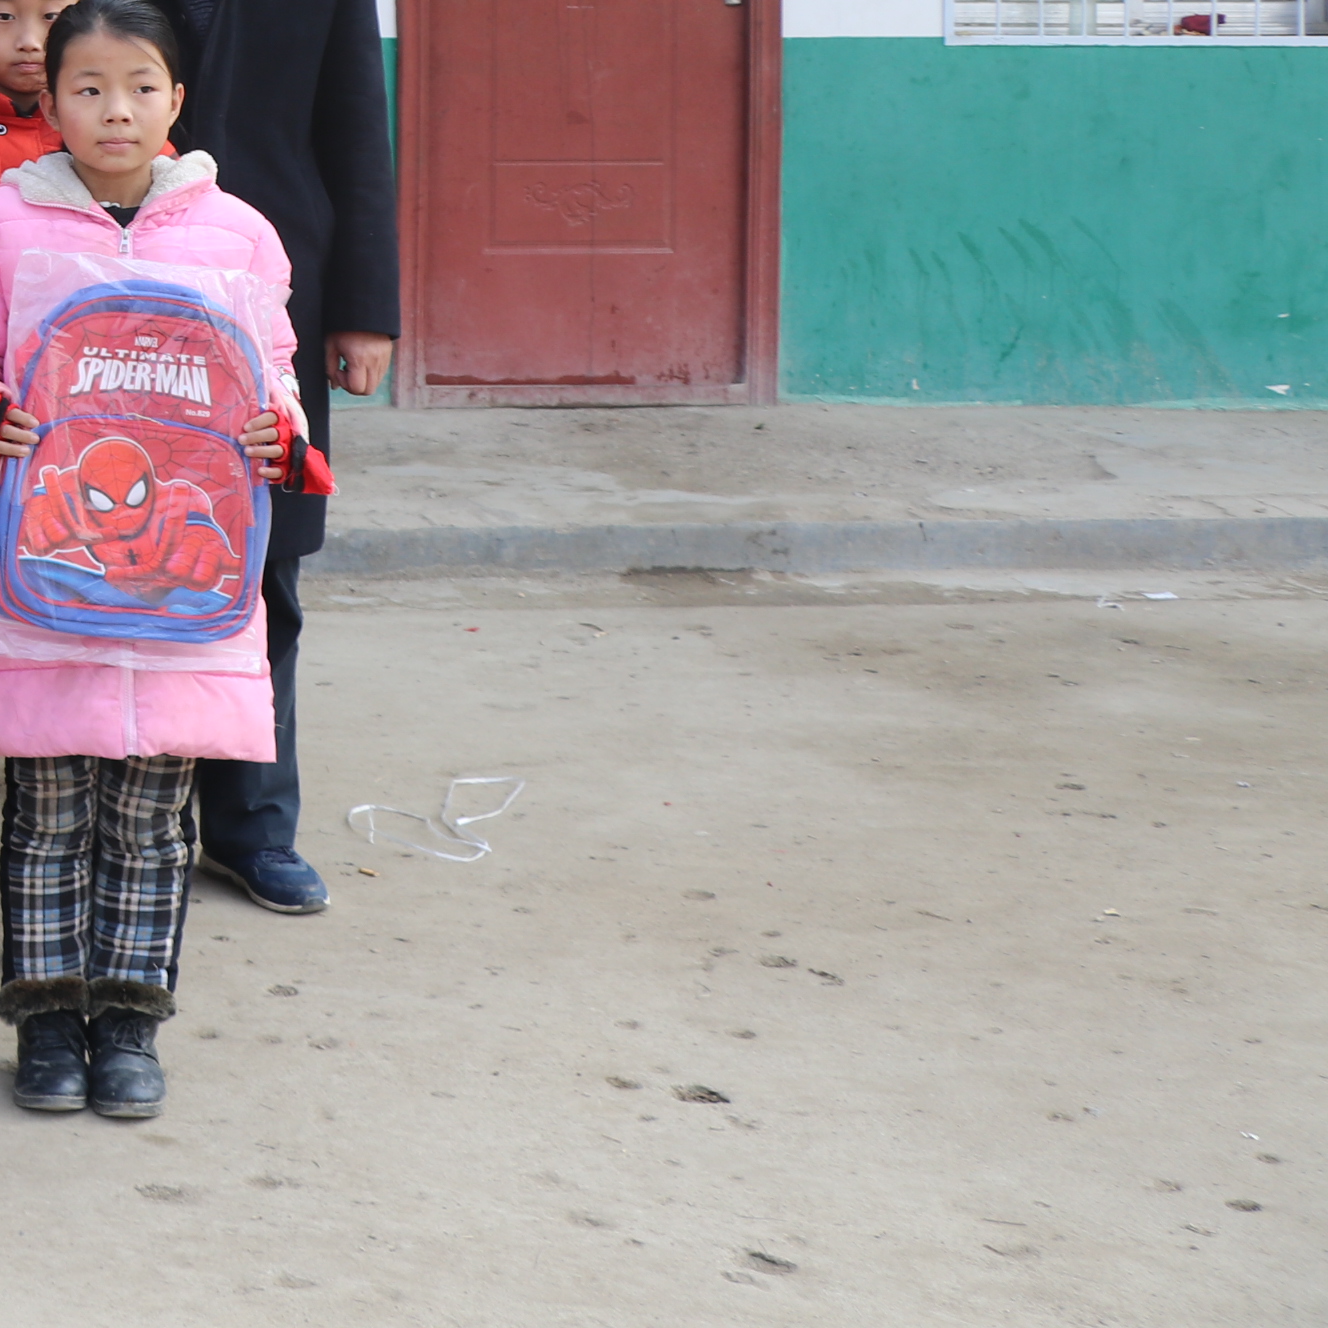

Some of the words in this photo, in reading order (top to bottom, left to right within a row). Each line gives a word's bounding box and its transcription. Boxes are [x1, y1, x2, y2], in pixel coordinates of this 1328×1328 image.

[134, 336, 159, 348] MARVEL
[83, 346, 207, 365] ULTIMATE
[70, 357, 212, 407] SPIDER-MAN
[185, 409, 211, 417] No.829
